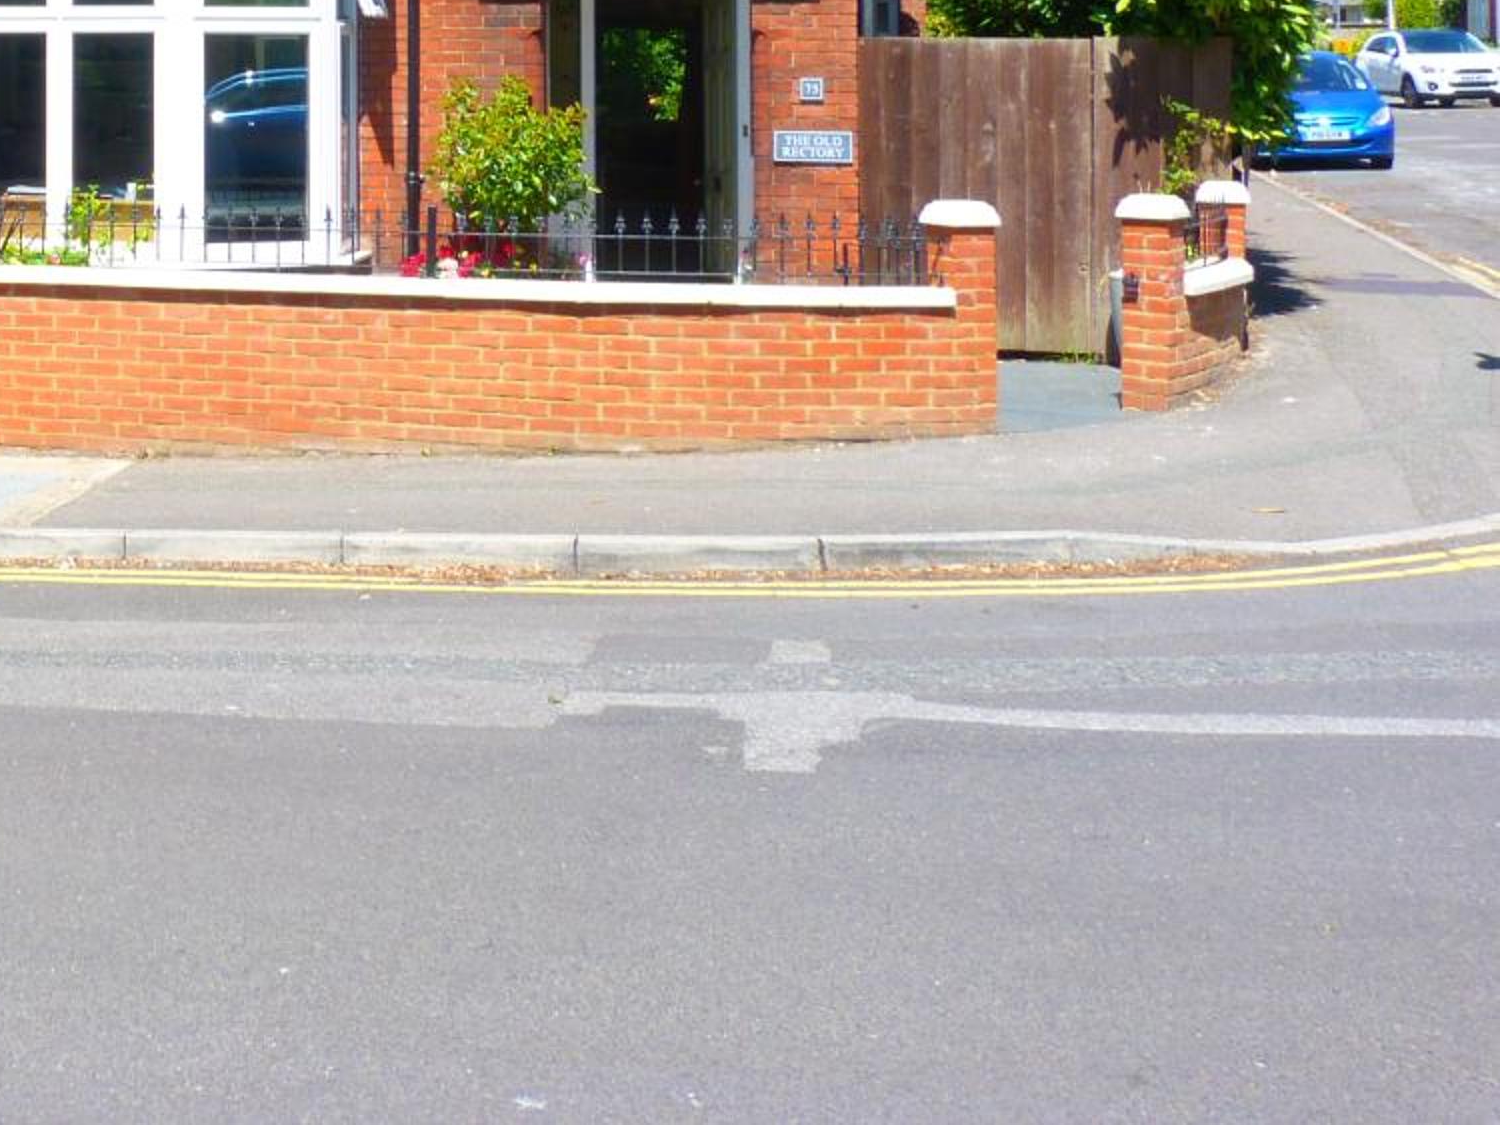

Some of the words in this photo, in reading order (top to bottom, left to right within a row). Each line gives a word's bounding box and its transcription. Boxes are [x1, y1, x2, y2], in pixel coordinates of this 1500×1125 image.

[784, 135, 809, 146] THE
[813, 135, 843, 146] OLD
[781, 146, 844, 158] RECTORY
